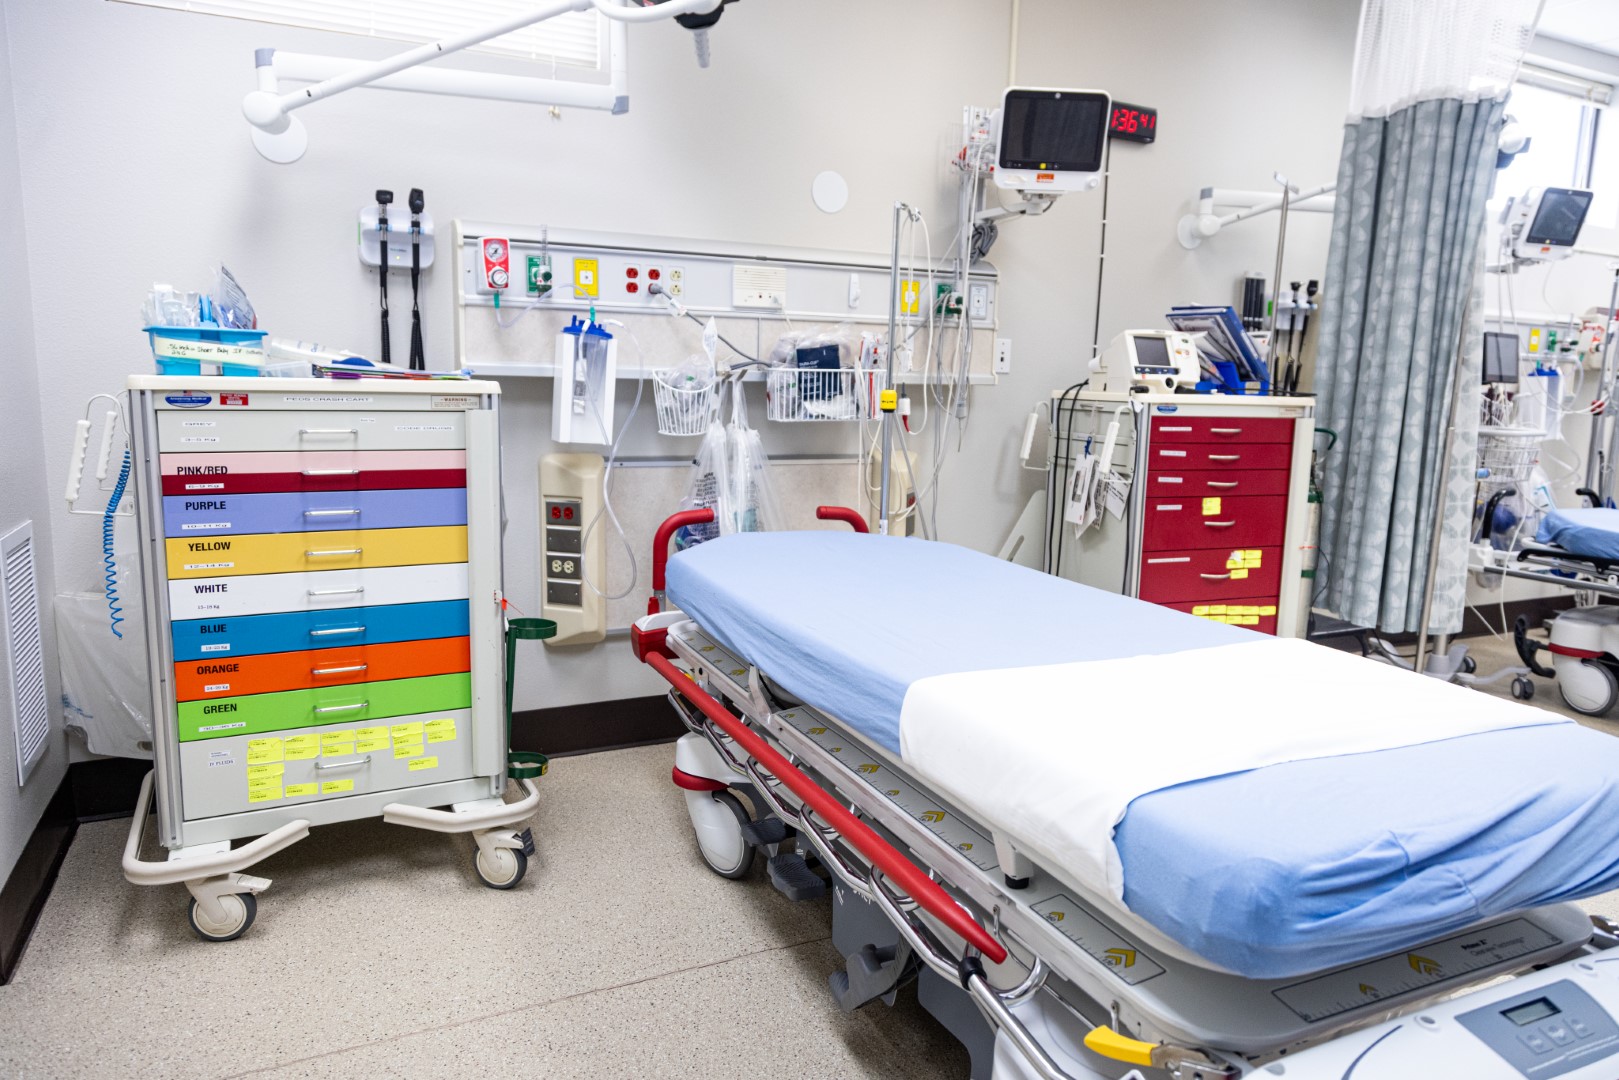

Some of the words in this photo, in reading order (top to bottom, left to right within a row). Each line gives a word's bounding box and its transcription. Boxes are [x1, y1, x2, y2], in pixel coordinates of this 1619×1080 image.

[177, 466, 228, 475] PINK/RED
[185, 501, 226, 510] PURPLE
[188, 542, 231, 551] YELLOW
[194, 584, 228, 594] WHITE
[200, 624, 227, 634] BLUE
[197, 664, 240, 674] ORANGE
[203, 703, 237, 714] GREEN
